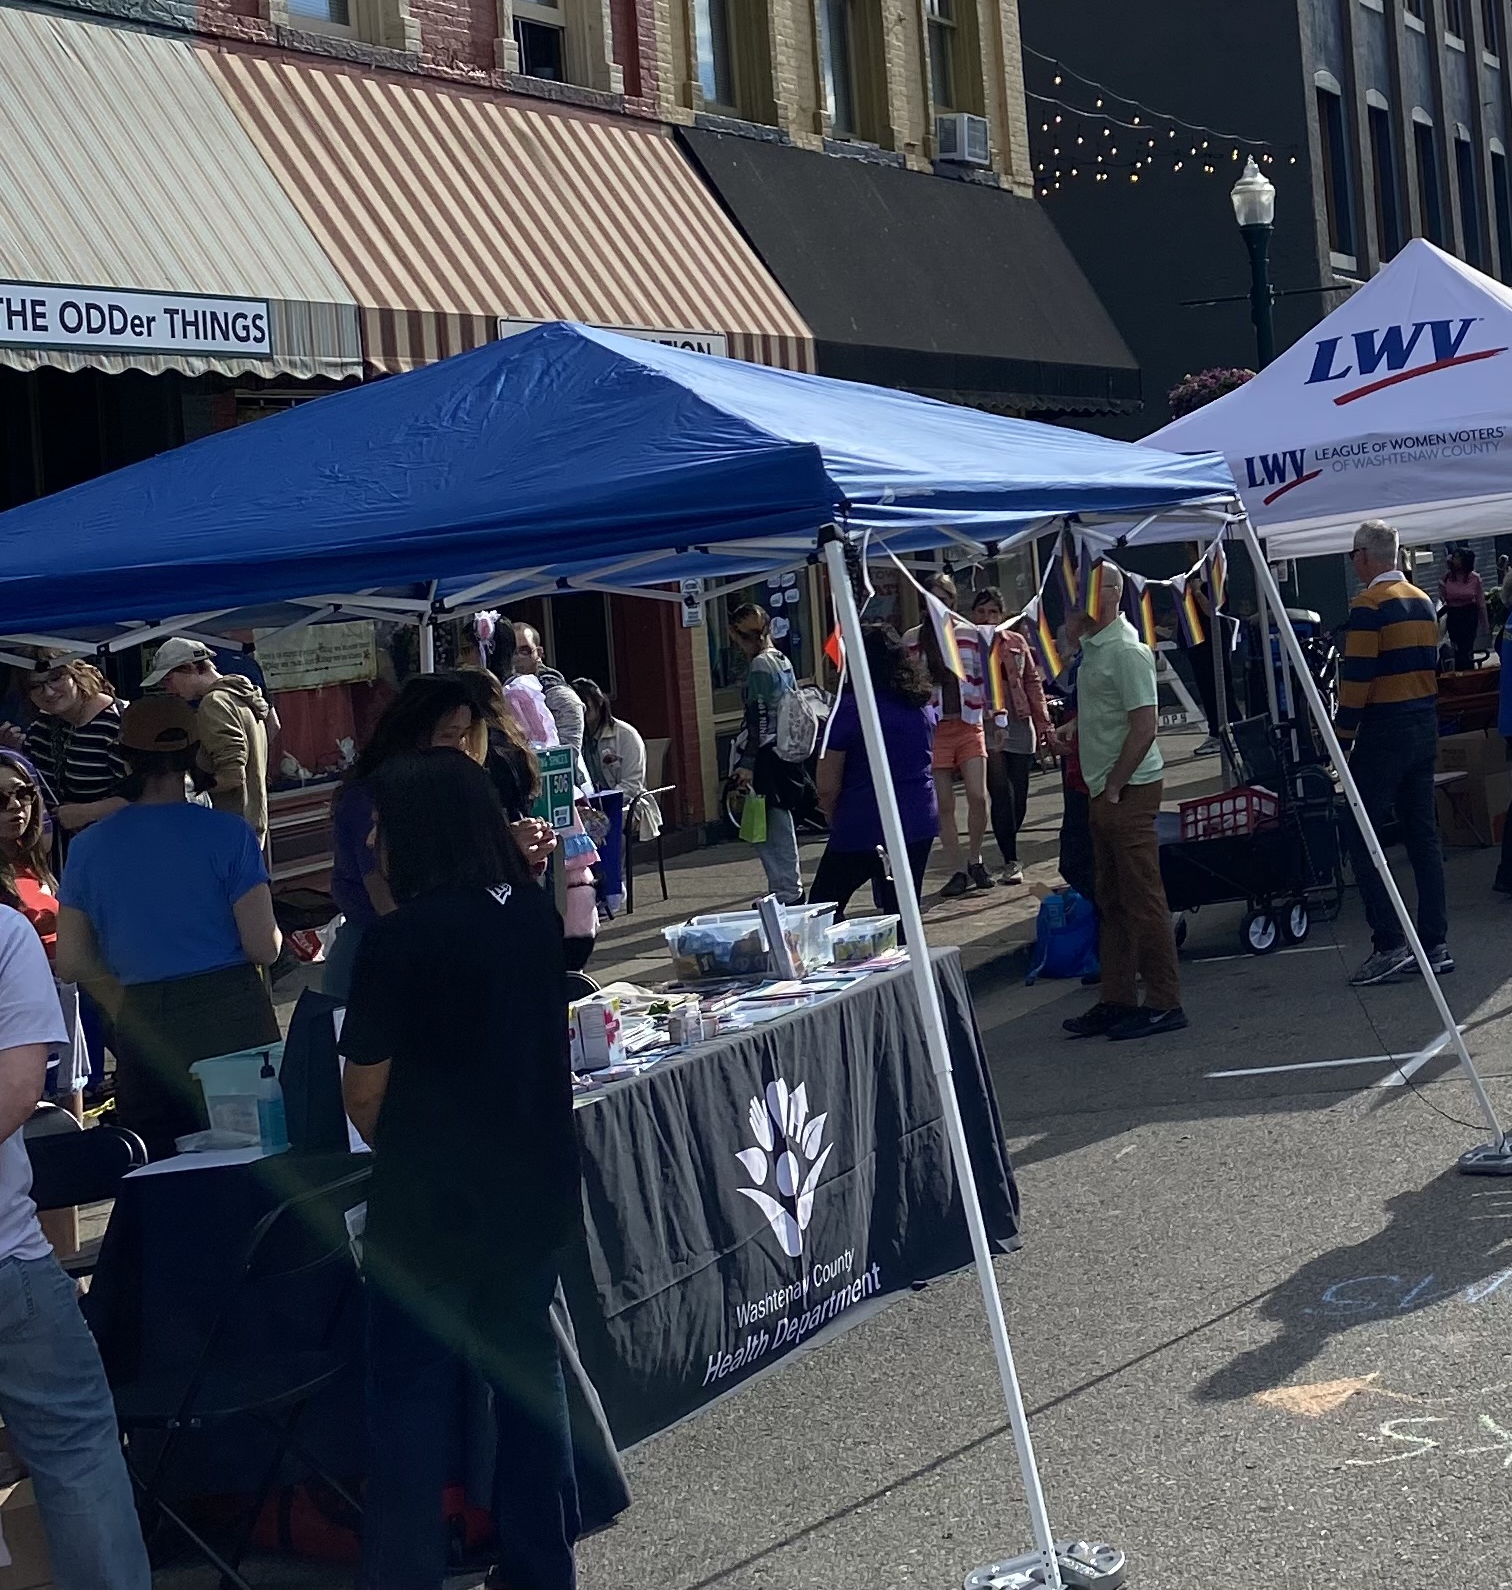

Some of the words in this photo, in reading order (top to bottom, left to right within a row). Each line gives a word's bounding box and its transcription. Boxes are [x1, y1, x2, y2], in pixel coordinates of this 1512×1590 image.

[58, 300, 157, 338] ODDer
[163, 307, 266, 344] THINGS
[1303, 317, 1477, 385] LWV
[1314, 442, 1370, 461] LEAGUE
[1389, 433, 1447, 451] WOMEN
[1448, 426, 1504, 443] VOTERS
[1332, 459, 1352, 473] OF
[1352, 447, 1439, 470] WASHTENAW
[1442, 440, 1501, 458] COUNTY
[1245, 448, 1306, 488] LWV
[554, 774, 568, 794] 506
[736, 1276, 810, 1328] Washtenaw
[813, 1248, 856, 1287] County
[702, 1328, 769, 1386] Health
[772, 1261, 882, 1352] Department
